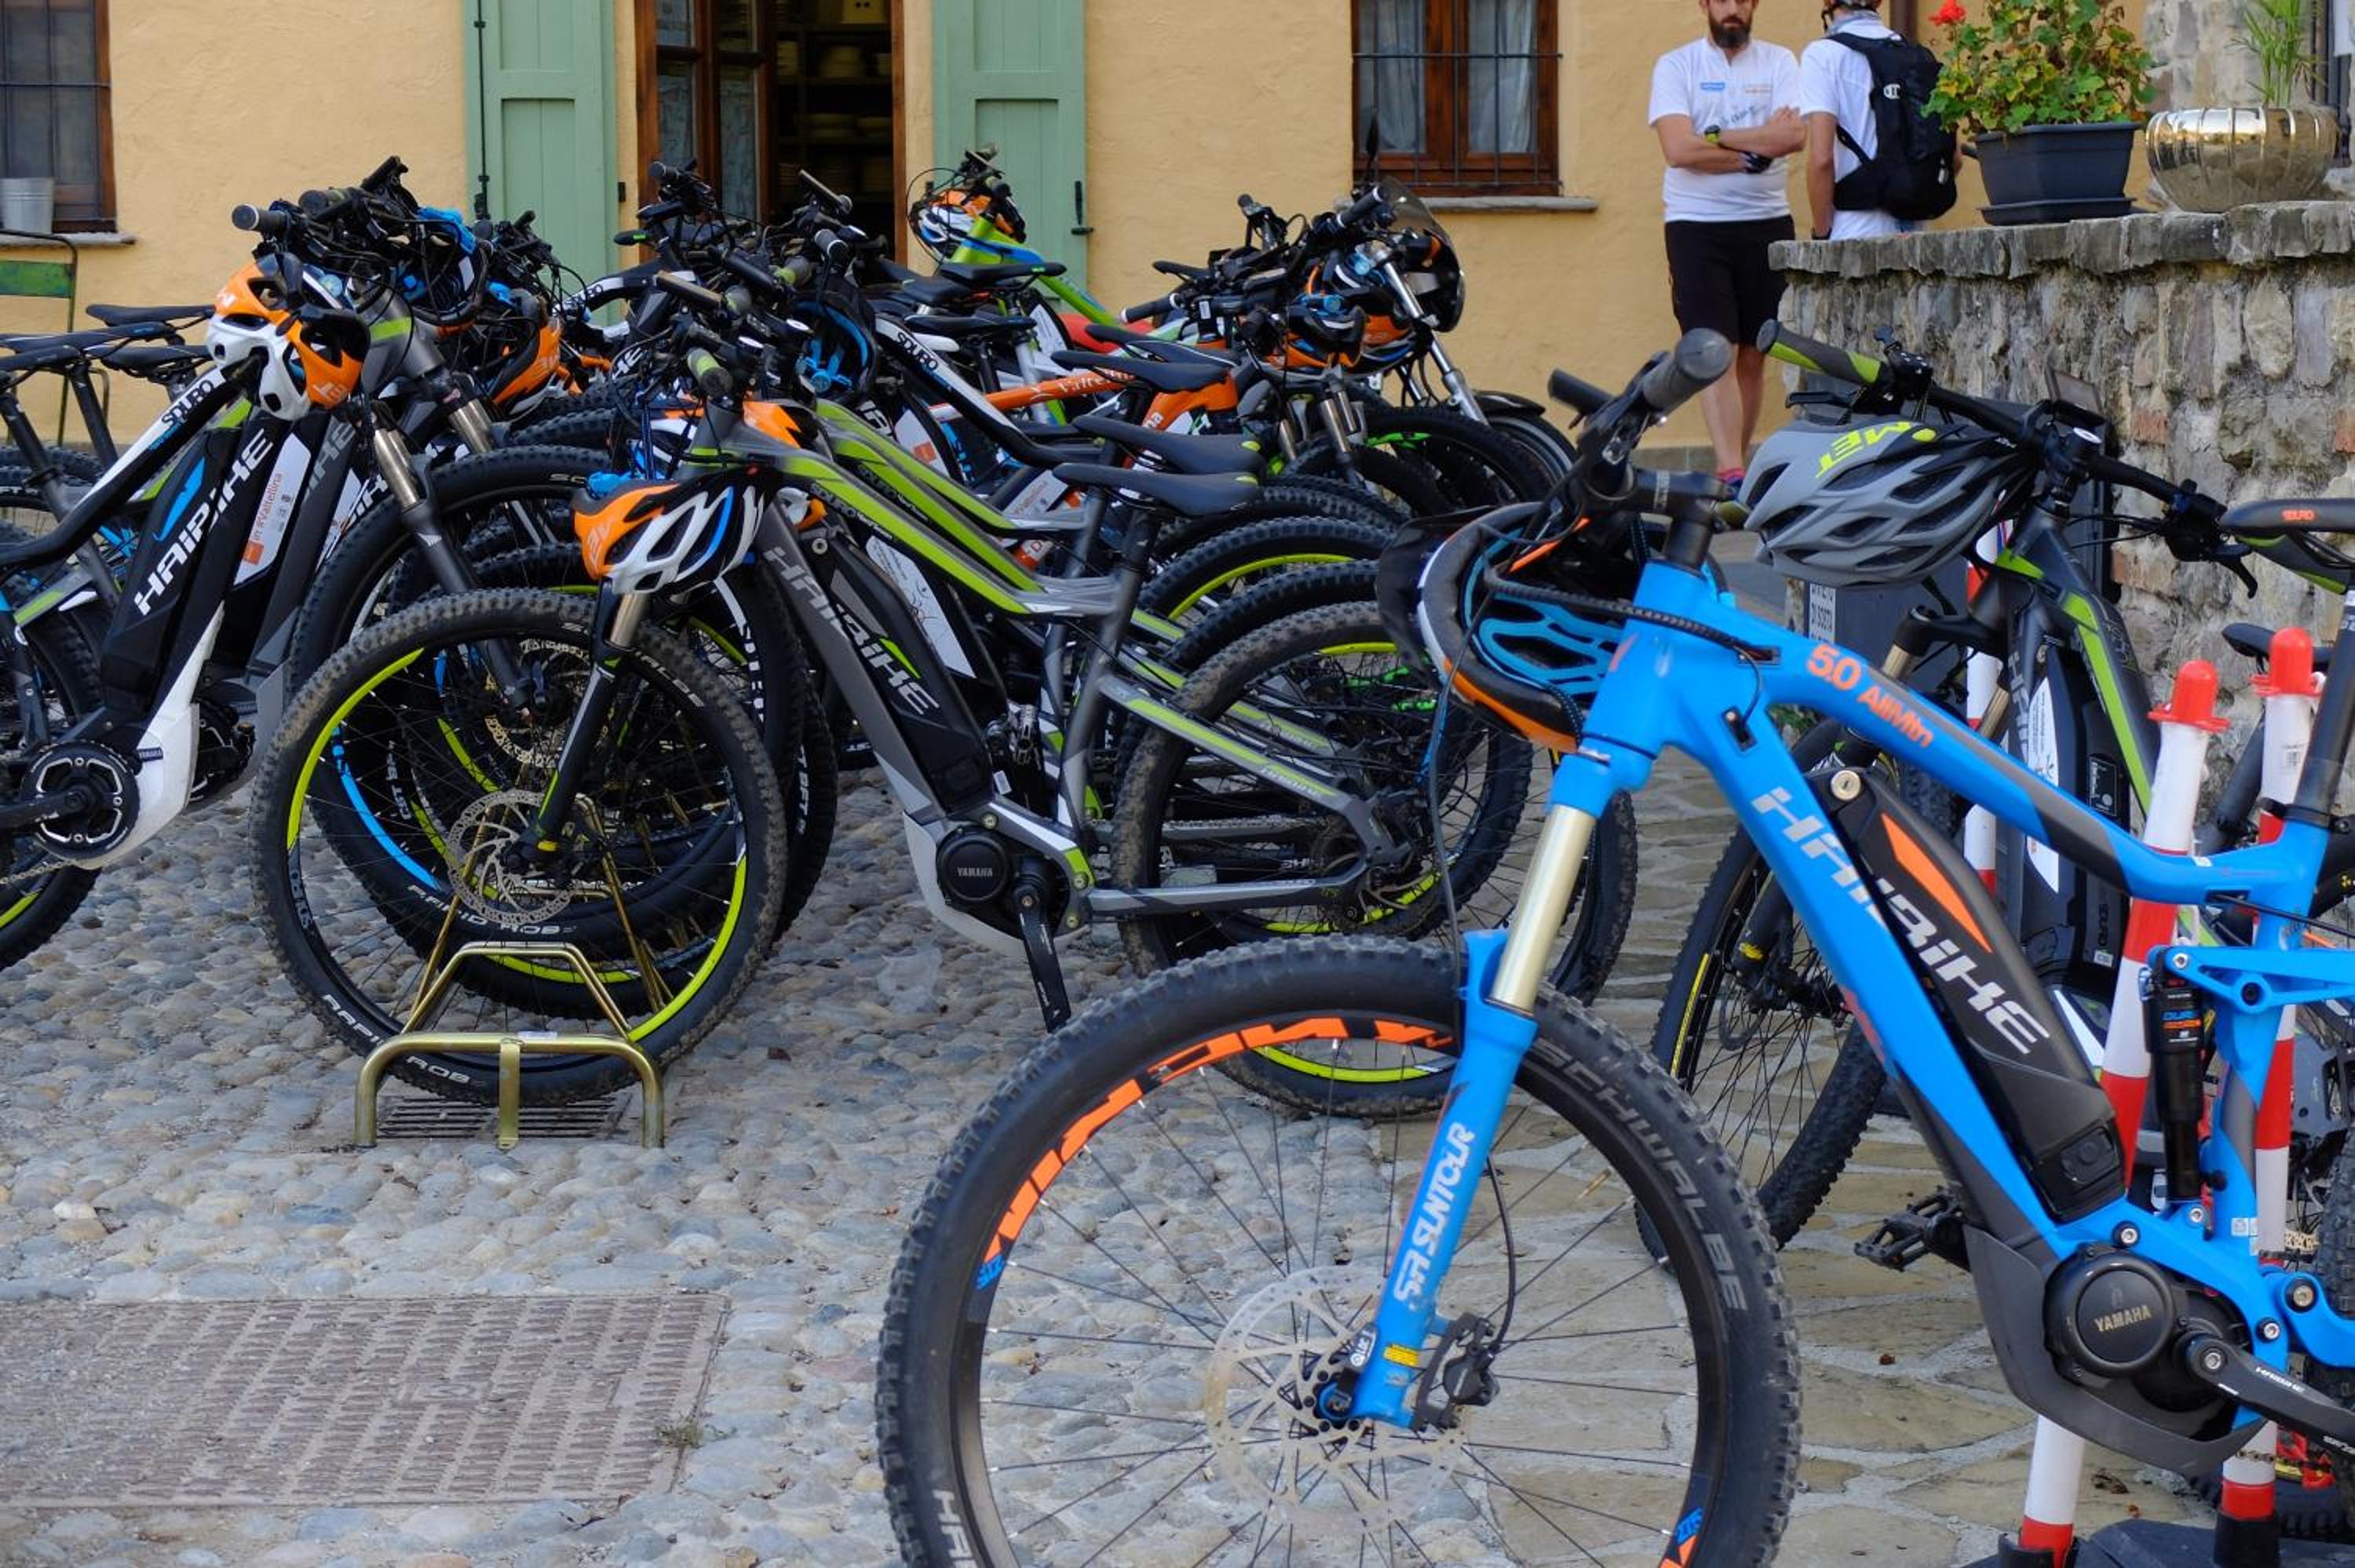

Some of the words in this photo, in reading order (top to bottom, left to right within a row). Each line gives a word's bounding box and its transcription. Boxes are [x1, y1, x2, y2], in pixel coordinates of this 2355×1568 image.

[897, 332, 938, 370] SDURO
[161, 379, 214, 425] SDURO
[1816, 421, 1910, 478] MET
[1807, 643, 1862, 691] 5.0
[957, 867, 994, 877] YAMAHA
[1751, 786, 2050, 1056] HAIBIKE
[321, 993, 385, 1048] RAPI
[1413, 1121, 1476, 1256] SUNTOUR
[1529, 1037, 1747, 1311] SCHWALBE
[2094, 1305, 2152, 1333] YAMAHA
